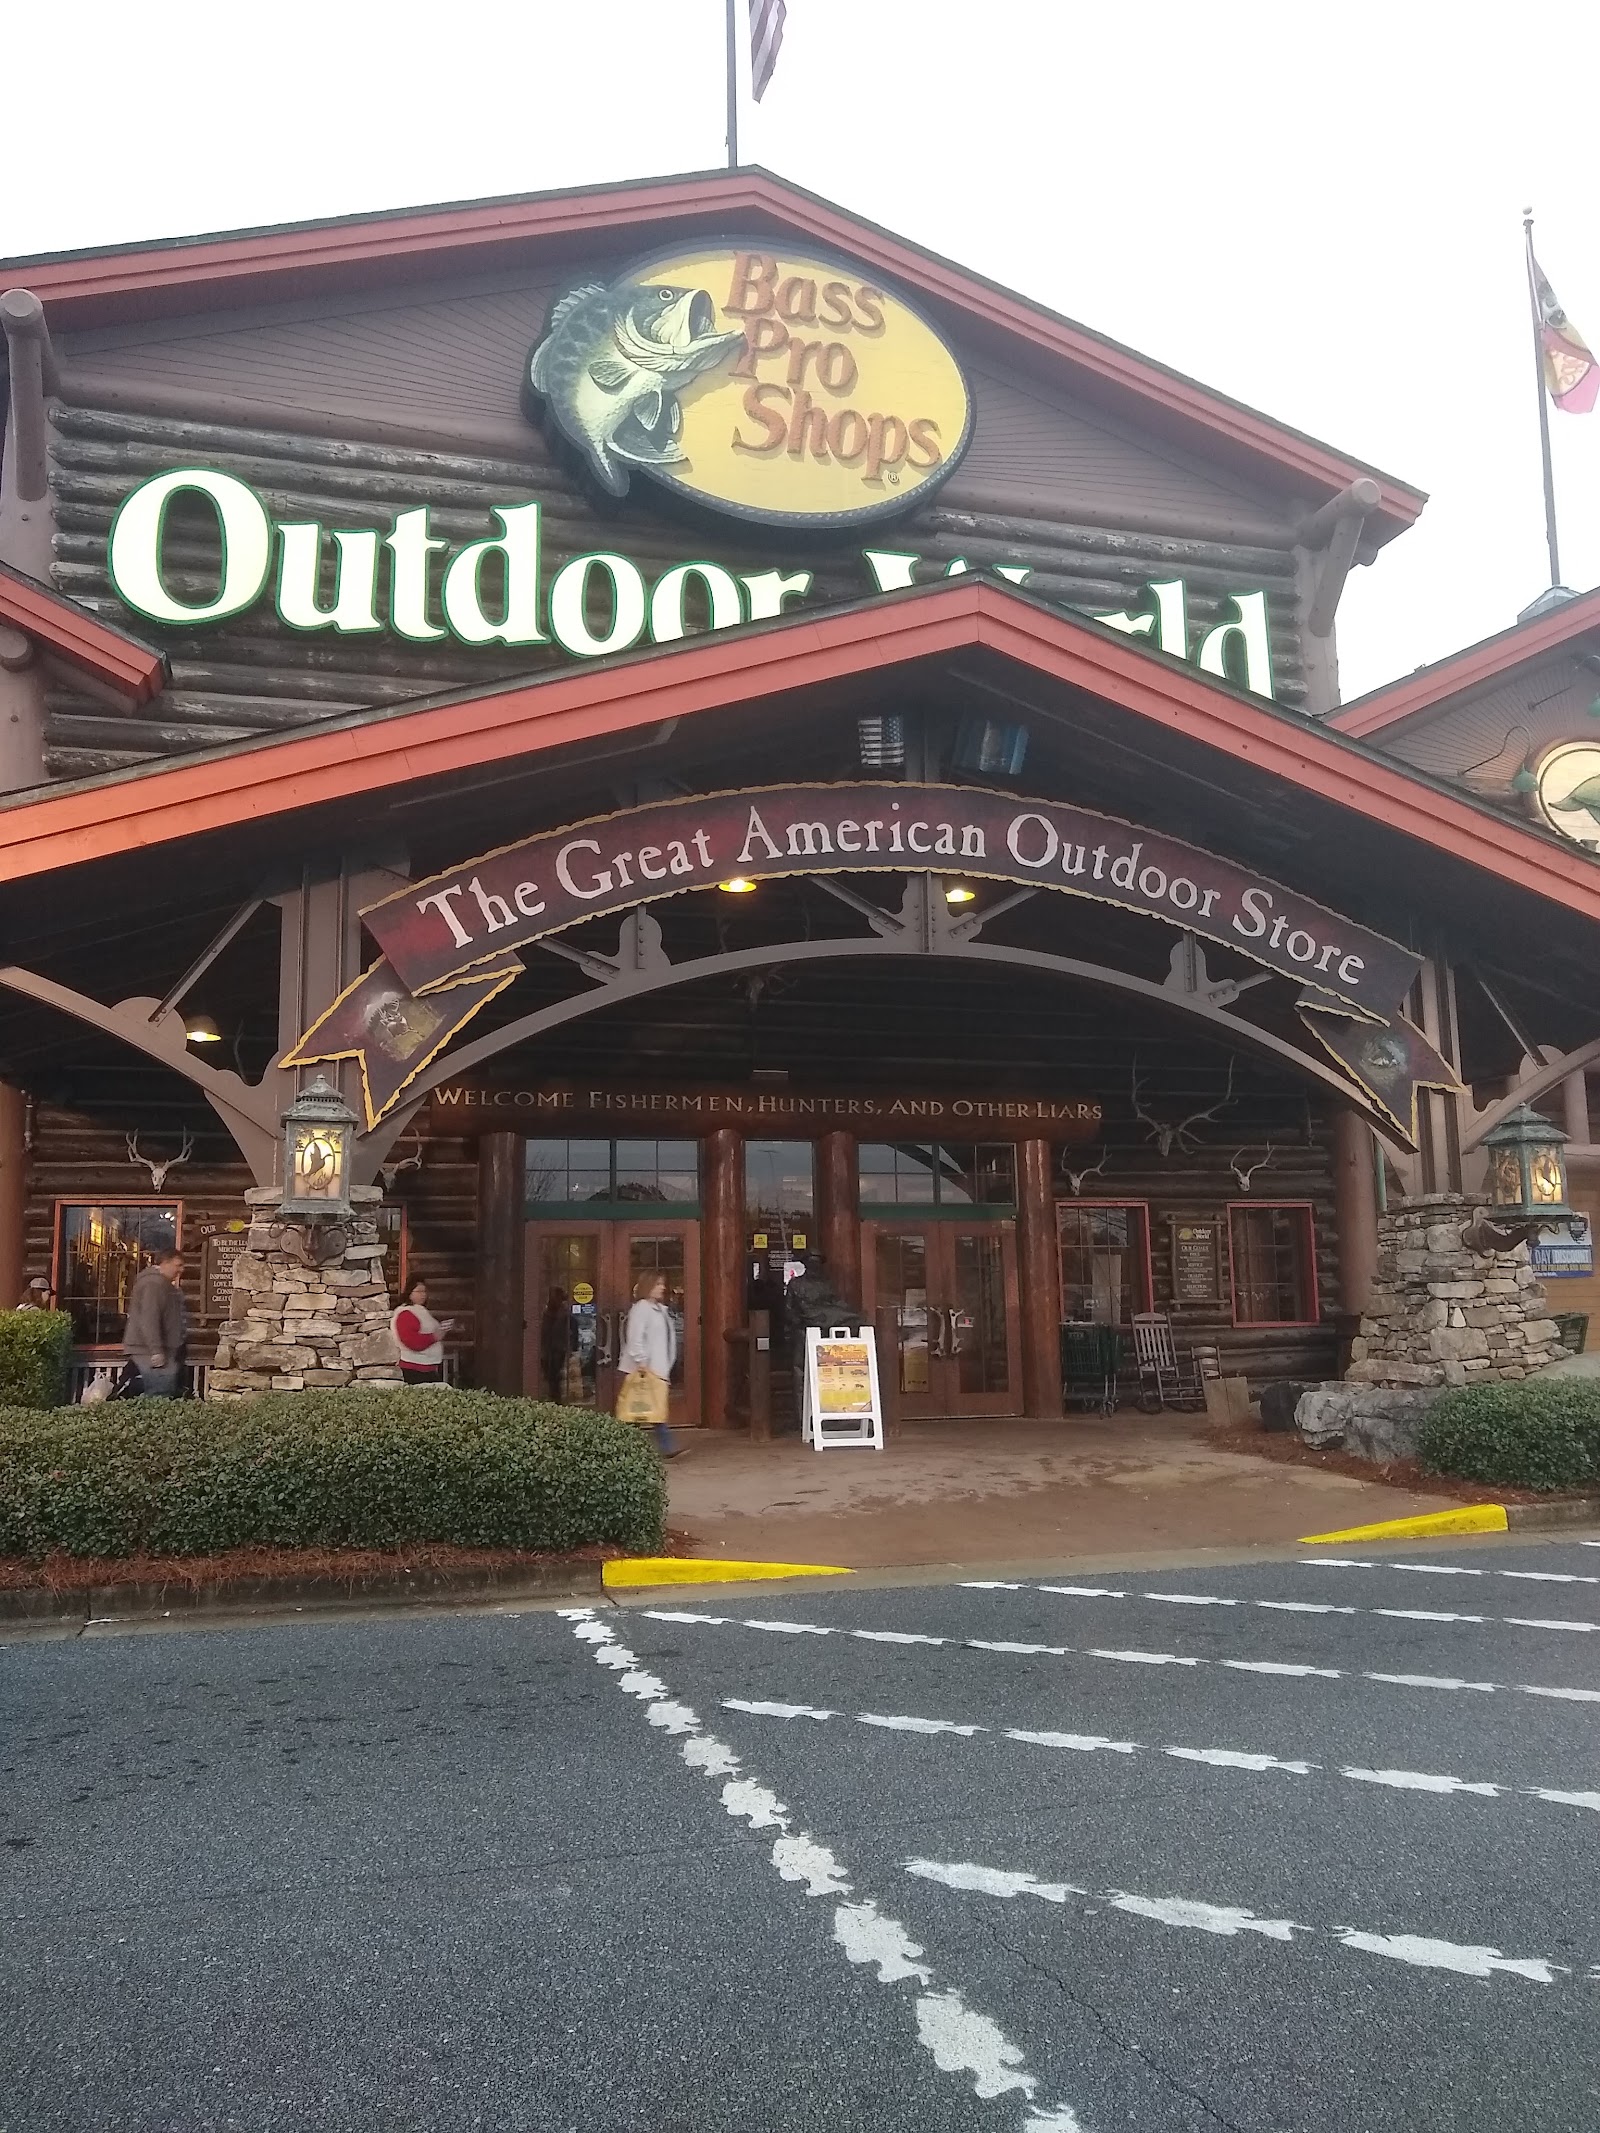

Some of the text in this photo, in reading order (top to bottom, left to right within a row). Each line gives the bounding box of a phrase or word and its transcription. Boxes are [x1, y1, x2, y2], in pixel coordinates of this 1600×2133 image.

[721, 250, 886, 333] Bass
[728, 315, 859, 390] Pro
[731, 382, 942, 482] Shops
[108, 466, 812, 659] Outdoor
[415, 802, 1366, 985] The Great American Outdoor Store
[434, 1086, 575, 1107] WELCOME
[888, 1099, 944, 1116] AND
[952, 1100, 1030, 1118] OTHER
[1037, 1102, 1103, 1119] LIARS
[200, 1224, 216, 1234] OUR
[212, 1238, 221, 1247] TO
[1534, 1249, 1551, 1264] DAY
